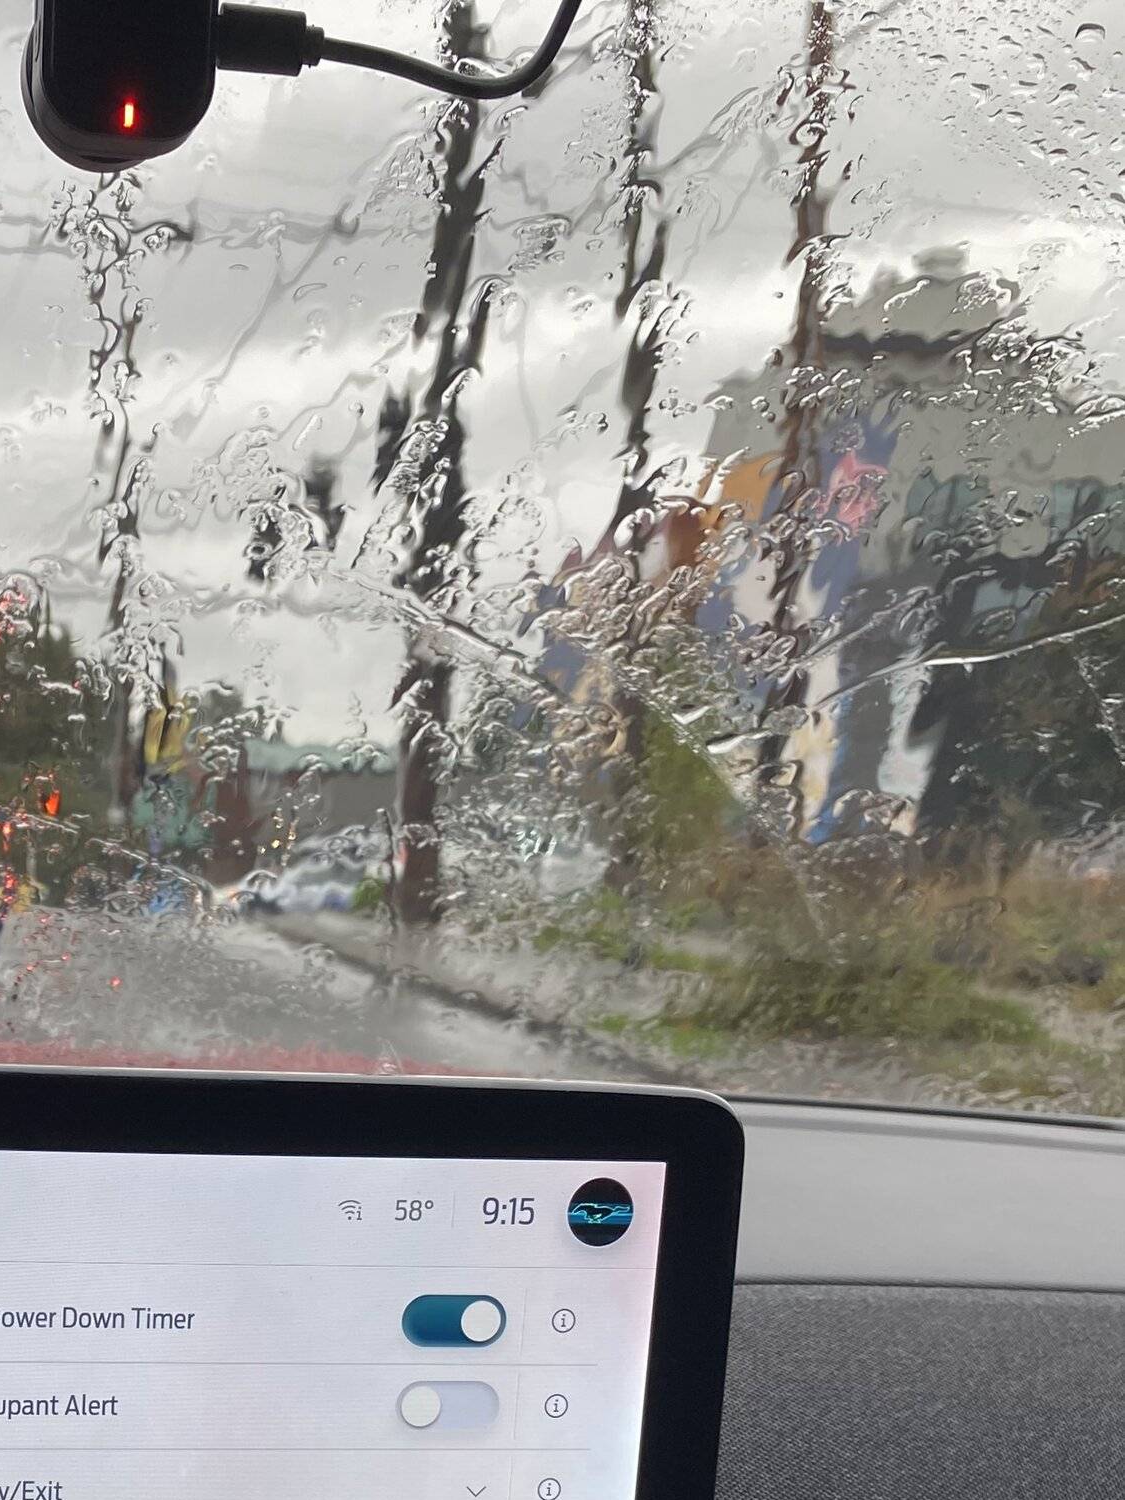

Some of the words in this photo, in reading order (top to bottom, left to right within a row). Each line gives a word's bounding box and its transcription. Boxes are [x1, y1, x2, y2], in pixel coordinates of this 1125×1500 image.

[395, 1200, 433, 1221] 58°
[483, 1198, 534, 1225] 9:15
[63, 1307, 124, 1328] Down
[131, 1308, 195, 1329] Timer
[65, 1394, 118, 1415] Alert
